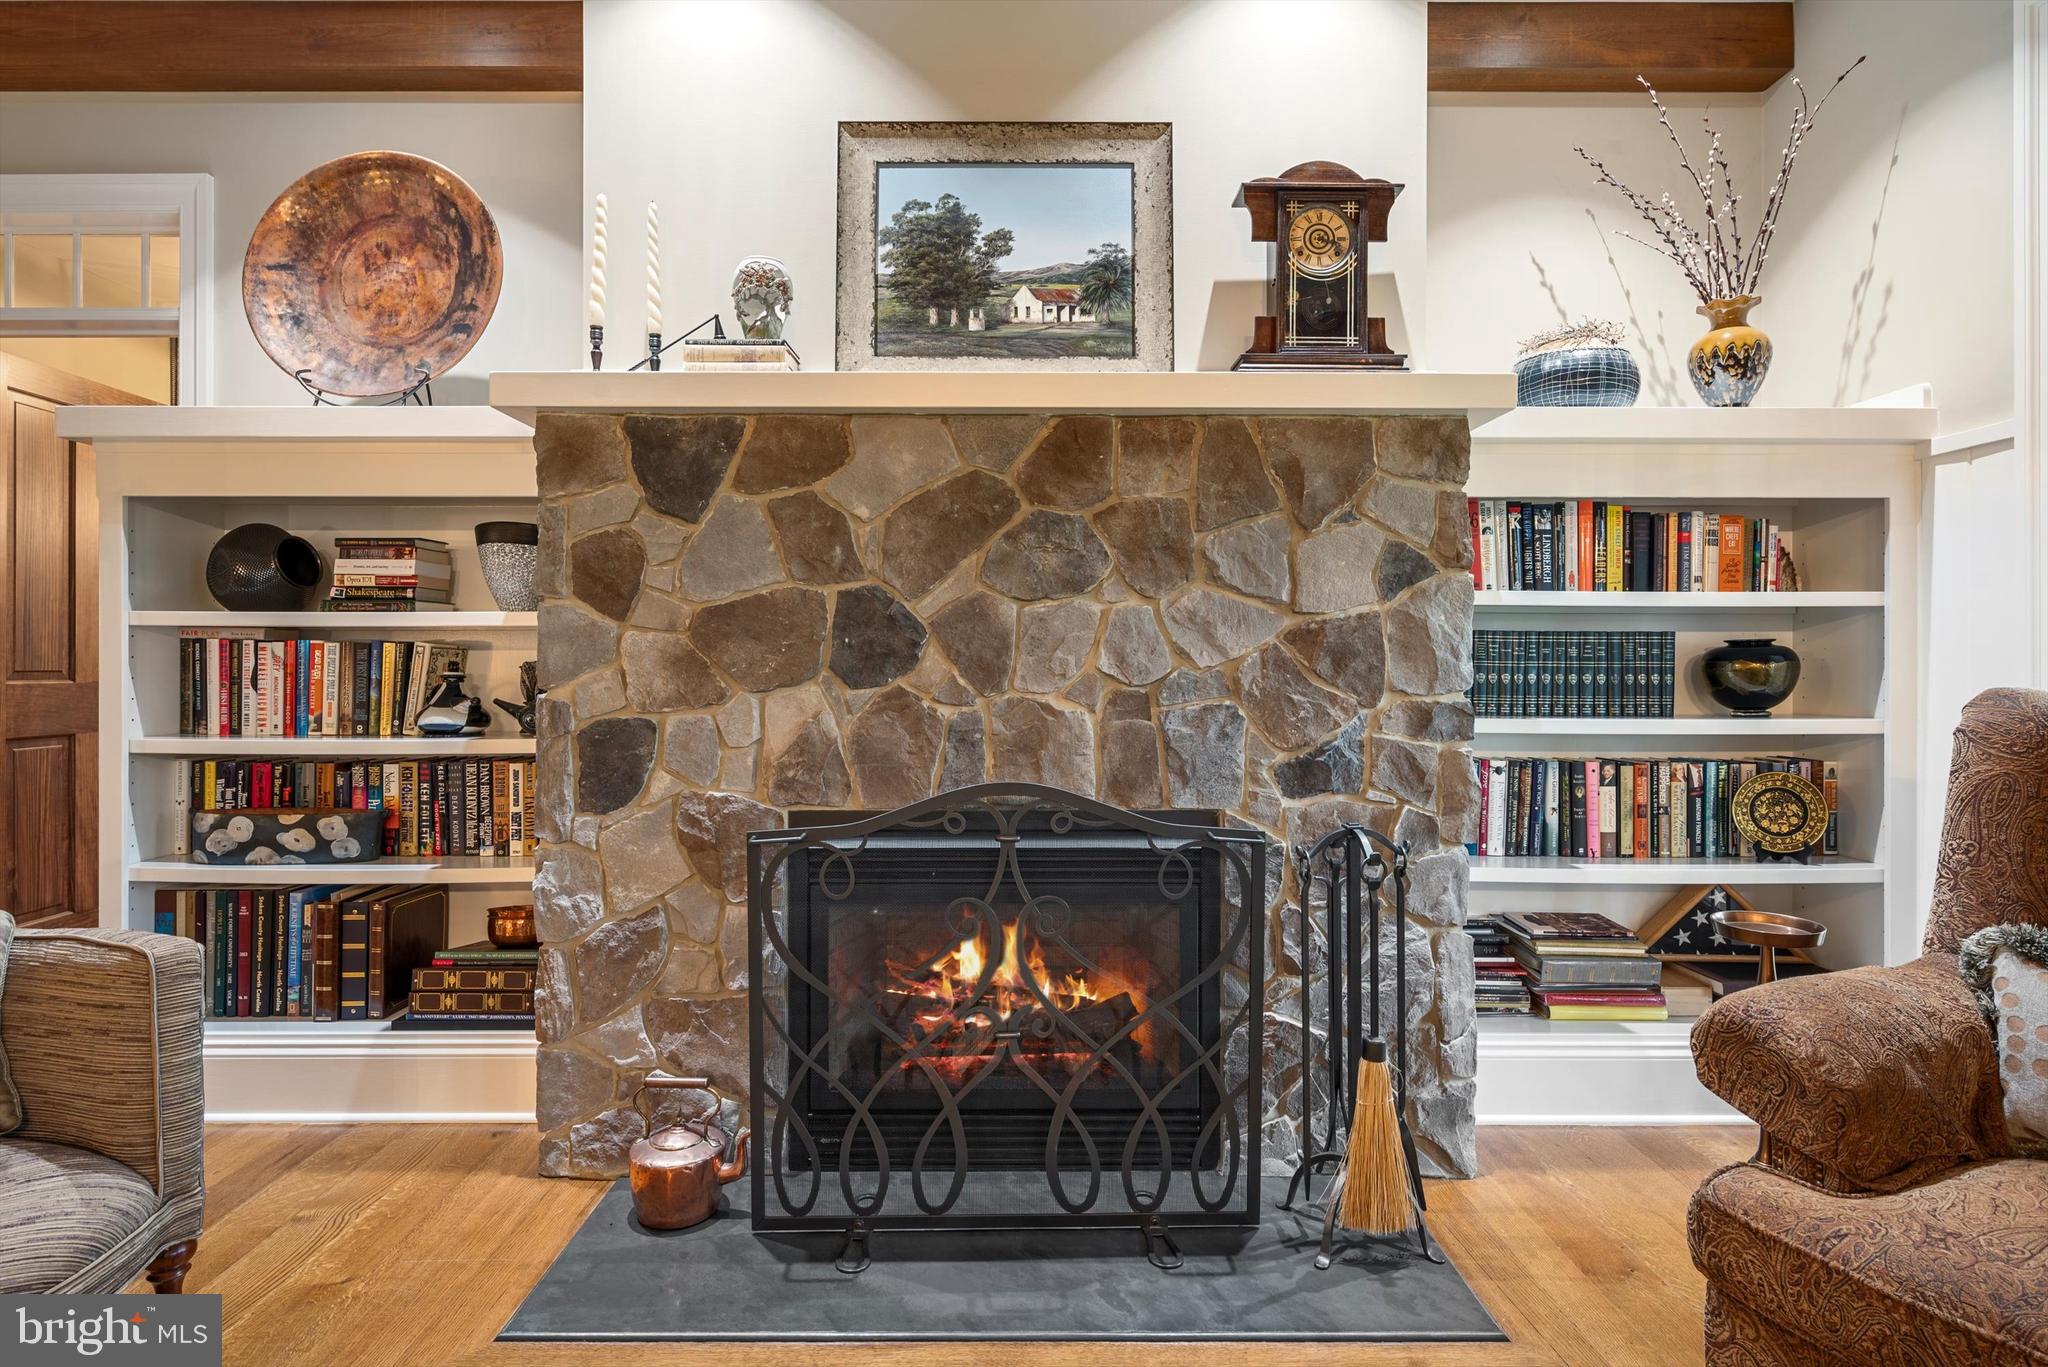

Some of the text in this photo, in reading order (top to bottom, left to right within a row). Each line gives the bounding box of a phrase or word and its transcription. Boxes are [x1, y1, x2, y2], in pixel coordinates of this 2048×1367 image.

[1542, 534, 1552, 583] LINDBERGH
[1594, 546, 1606, 584] LEADERS
[346, 576, 361, 585] Opera
[346, 587, 395, 598] Shakespeare
[272, 656, 281, 672] PREY
[314, 649, 322, 680] DEAD EVEN
[356, 649, 368, 662] THE
[356, 662, 368, 676] FIRST
[258, 646, 269, 728] MICHAEL CRICHTON
[328, 645, 337, 702] THE PUZZLE PALACE
[274, 766, 282, 778] The
[384, 771, 395, 794] Nelson
[465, 763, 478, 786] DEAN
[495, 764, 506, 798] DAN BROWN
[216, 779, 225, 802] Without
[225, 788, 236, 800] Tom
[274, 779, 282, 795] Bear
[283, 787, 291, 801] Tom
[401, 766, 414, 813] KEN FOLLETT
[420, 783, 430, 801] KEN
[438, 766, 446, 814] KEN FOLLETT
[480, 763, 490, 815] DAN BROWN
[465, 786, 478, 820] KOONTZ
[401, 816, 409, 844] FORTUNE
[420, 804, 430, 843] FOLLETT
[451, 795, 460, 847] DEAN KOONTZ
[484, 816, 492, 845] DECEPTION
[524, 796, 536, 840] TAKEOVER
[511, 828, 522, 841] PREY
[290, 902, 298, 936] JOURNEYS
[256, 937, 264, 961] Heritage
[276, 936, 284, 960] Heritage
[290, 946, 298, 977] LIFETIME
